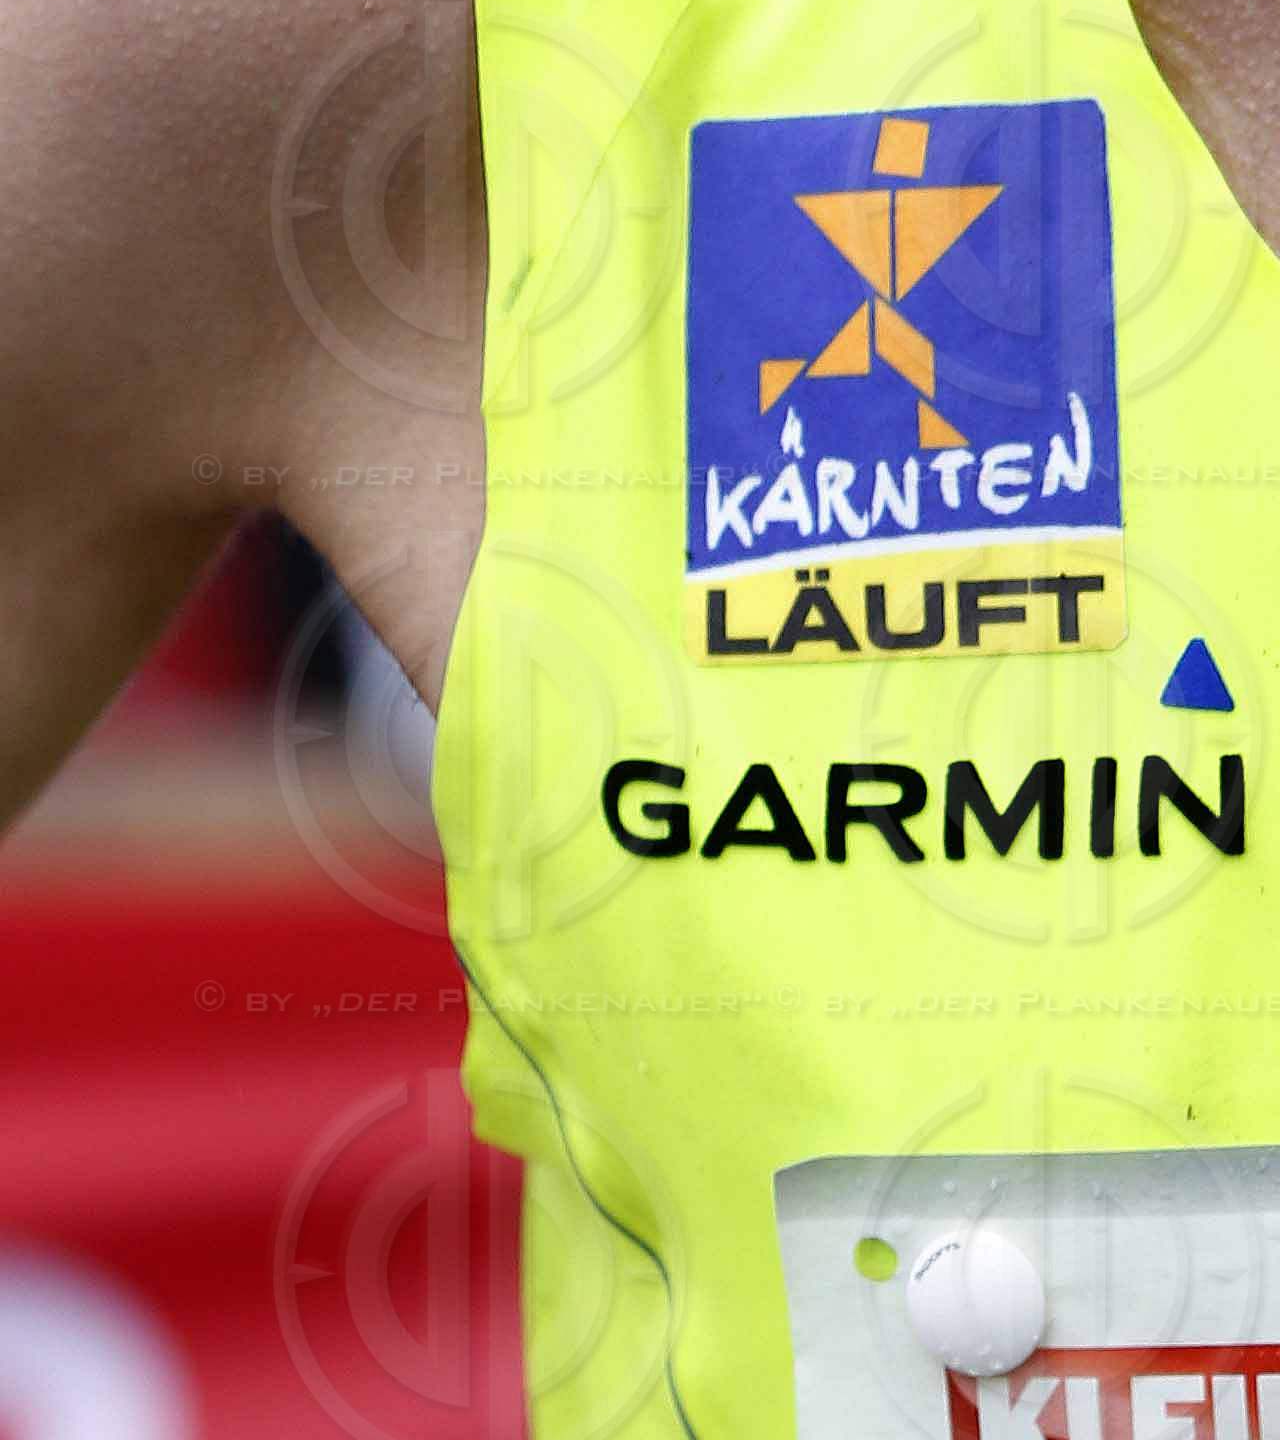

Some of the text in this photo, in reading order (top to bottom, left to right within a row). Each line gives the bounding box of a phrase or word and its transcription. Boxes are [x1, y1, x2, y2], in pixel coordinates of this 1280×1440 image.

[704, 392, 1093, 550] KÄRNTEN
[705, 571, 1104, 655] LÄUFT
[602, 754, 1246, 861] GARMIN
